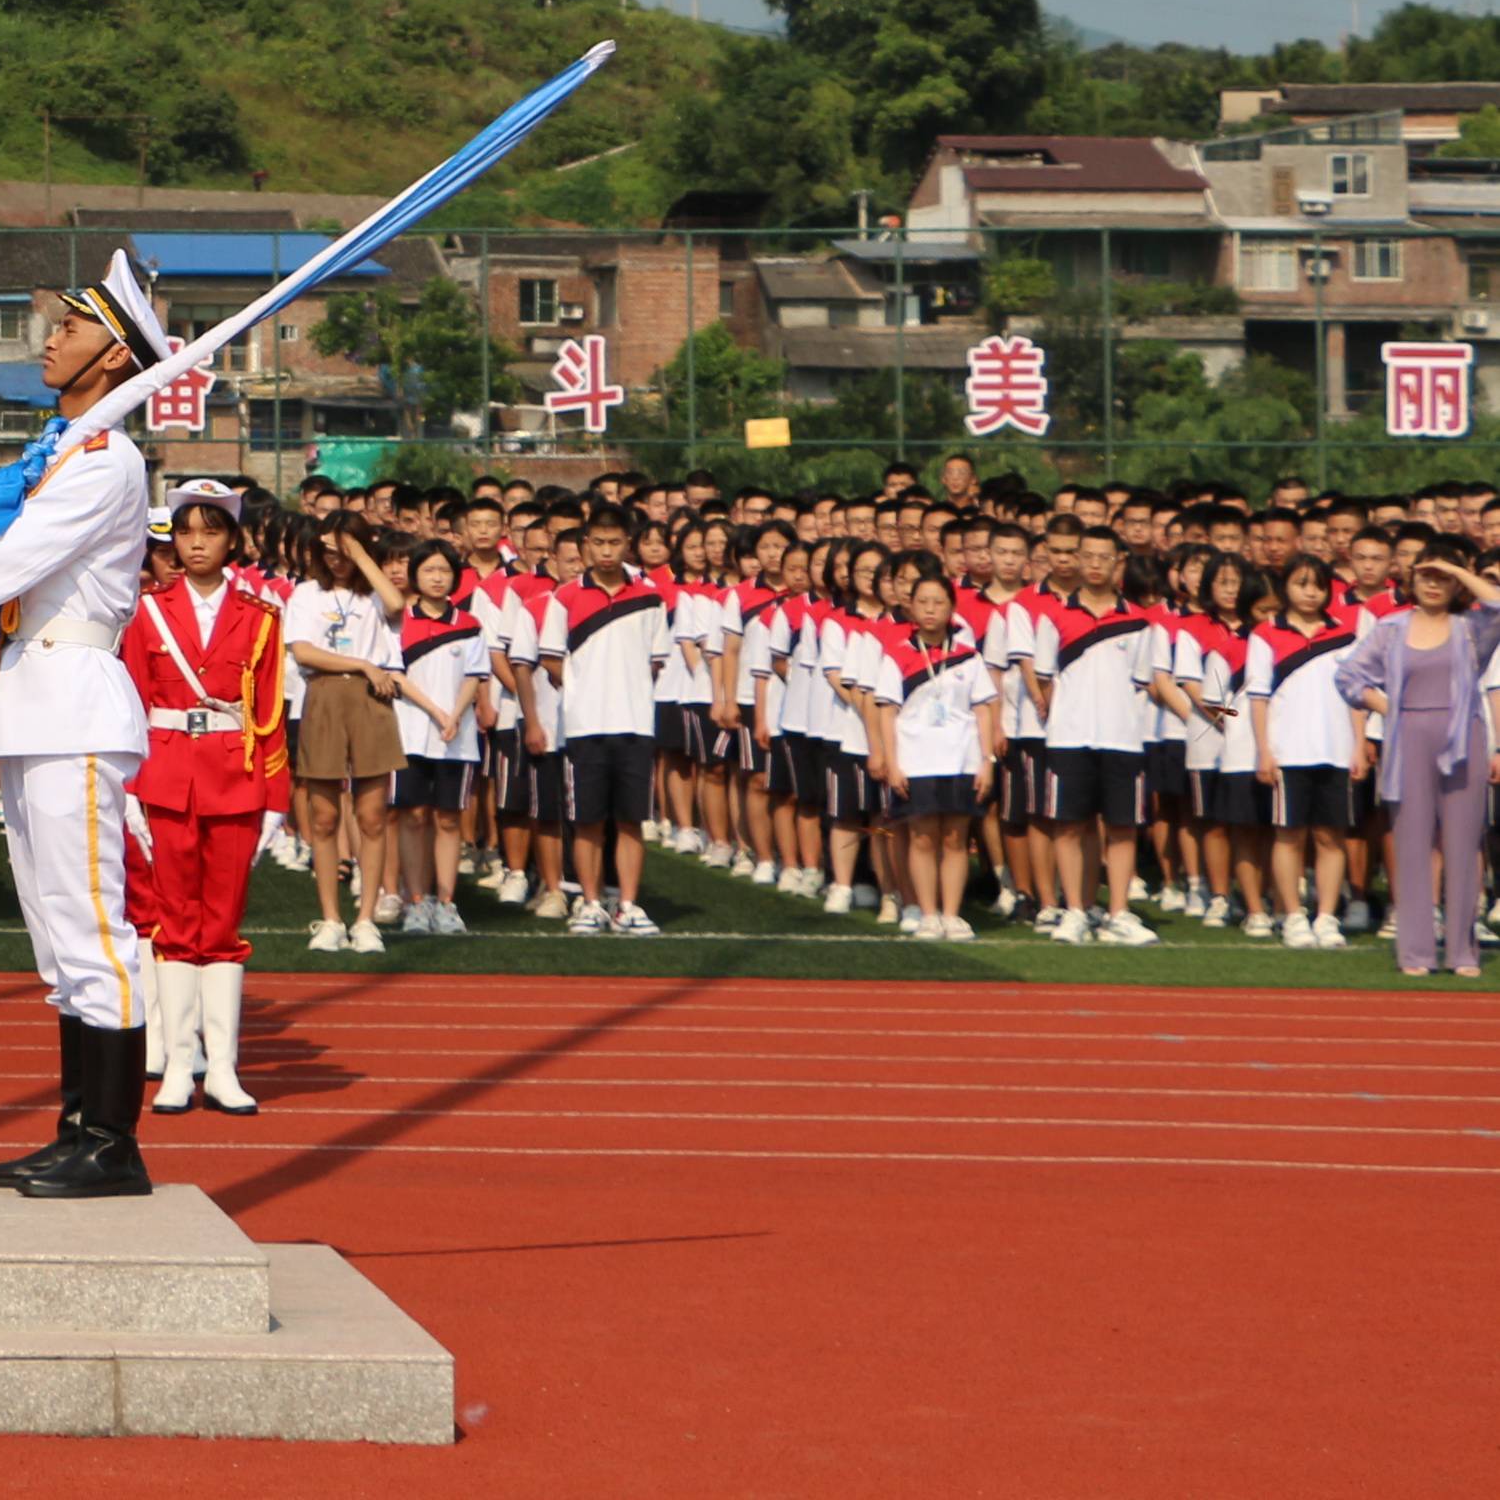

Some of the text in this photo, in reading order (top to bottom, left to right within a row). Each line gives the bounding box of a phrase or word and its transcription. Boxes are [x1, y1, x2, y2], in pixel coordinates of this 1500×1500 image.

[545, 335, 622, 431] 斗
[965, 336, 1049, 434] 美
[1382, 342, 1472, 434] 丽
